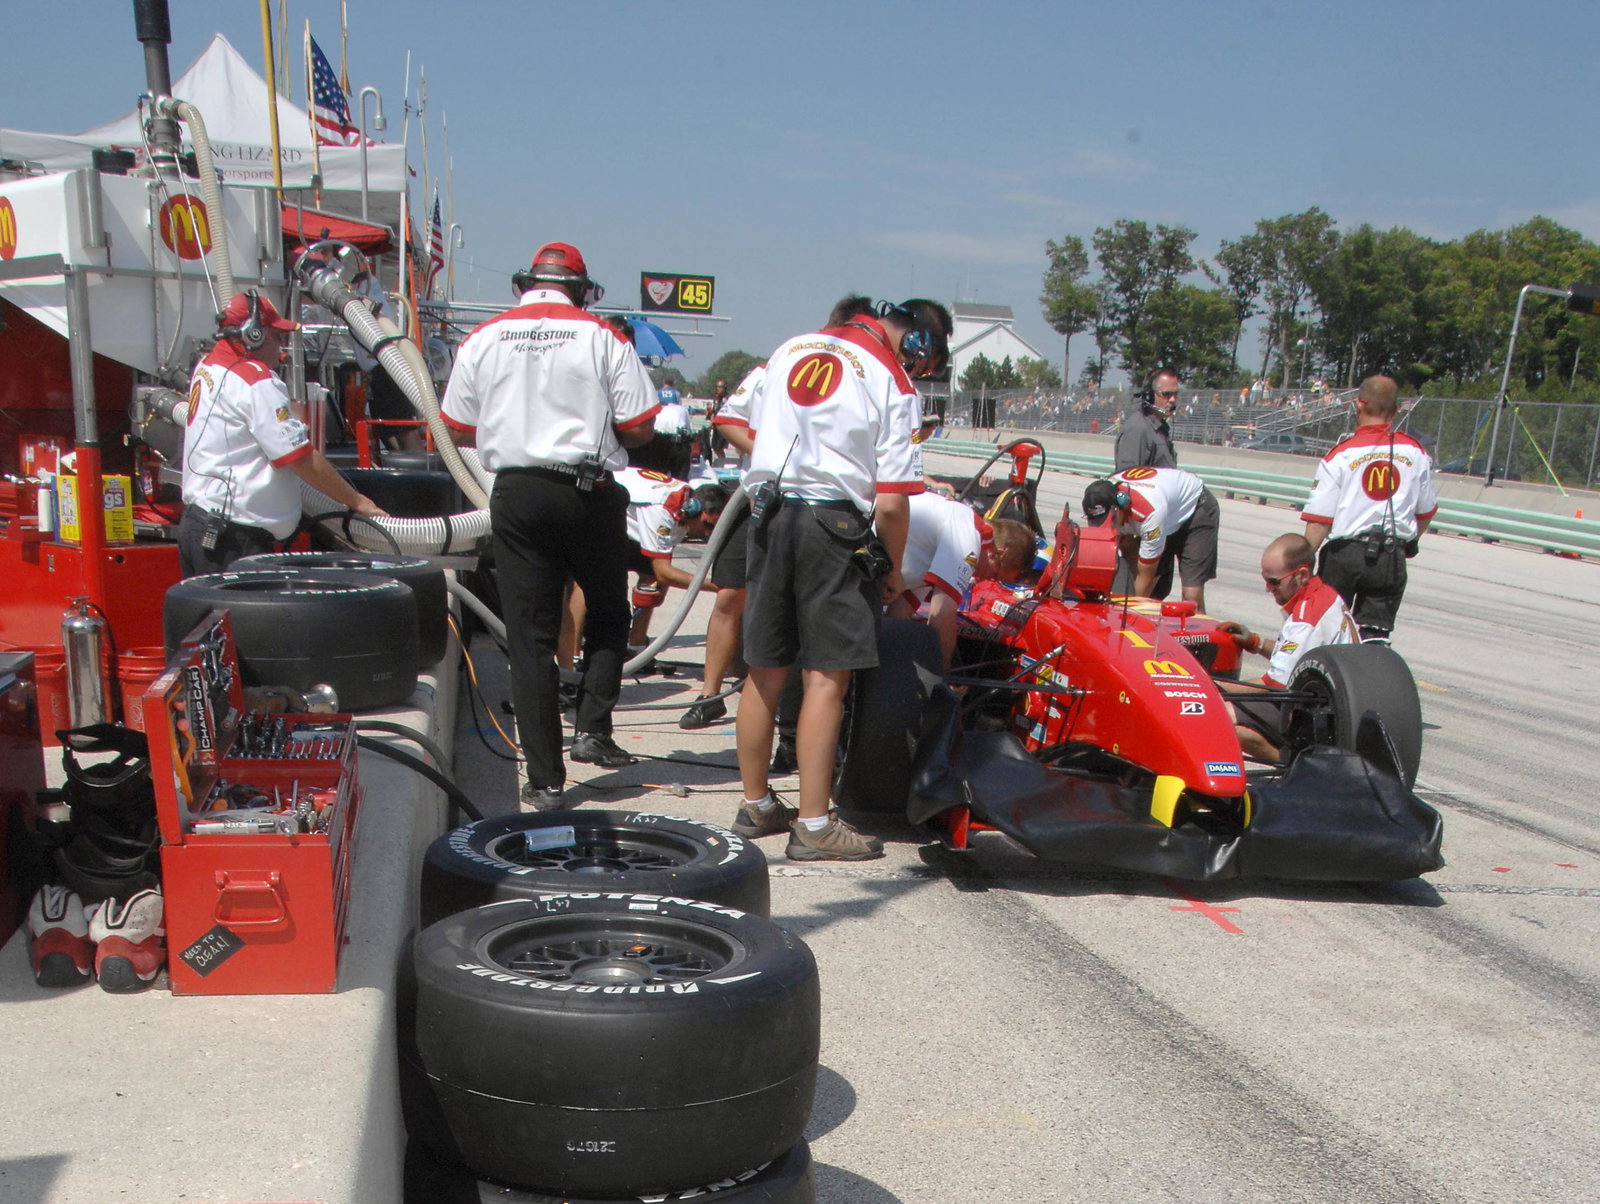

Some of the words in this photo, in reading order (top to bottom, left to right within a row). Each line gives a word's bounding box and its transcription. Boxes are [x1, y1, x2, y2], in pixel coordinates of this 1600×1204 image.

[682, 285, 708, 305] 45
[499, 330, 578, 342] BRIDGESTONE
[191, 671, 204, 700] CAR
[1163, 690, 1208, 699] BOSCH
[196, 702, 211, 748] CHAMP
[1208, 764, 1238, 773] DASANI
[539, 892, 746, 919] POTENZA
[183, 942, 205, 961] NEED
[202, 932, 216, 945] TO
[196, 937, 230, 967] CLEAN
[456, 963, 700, 994] BRIDGESTONE
